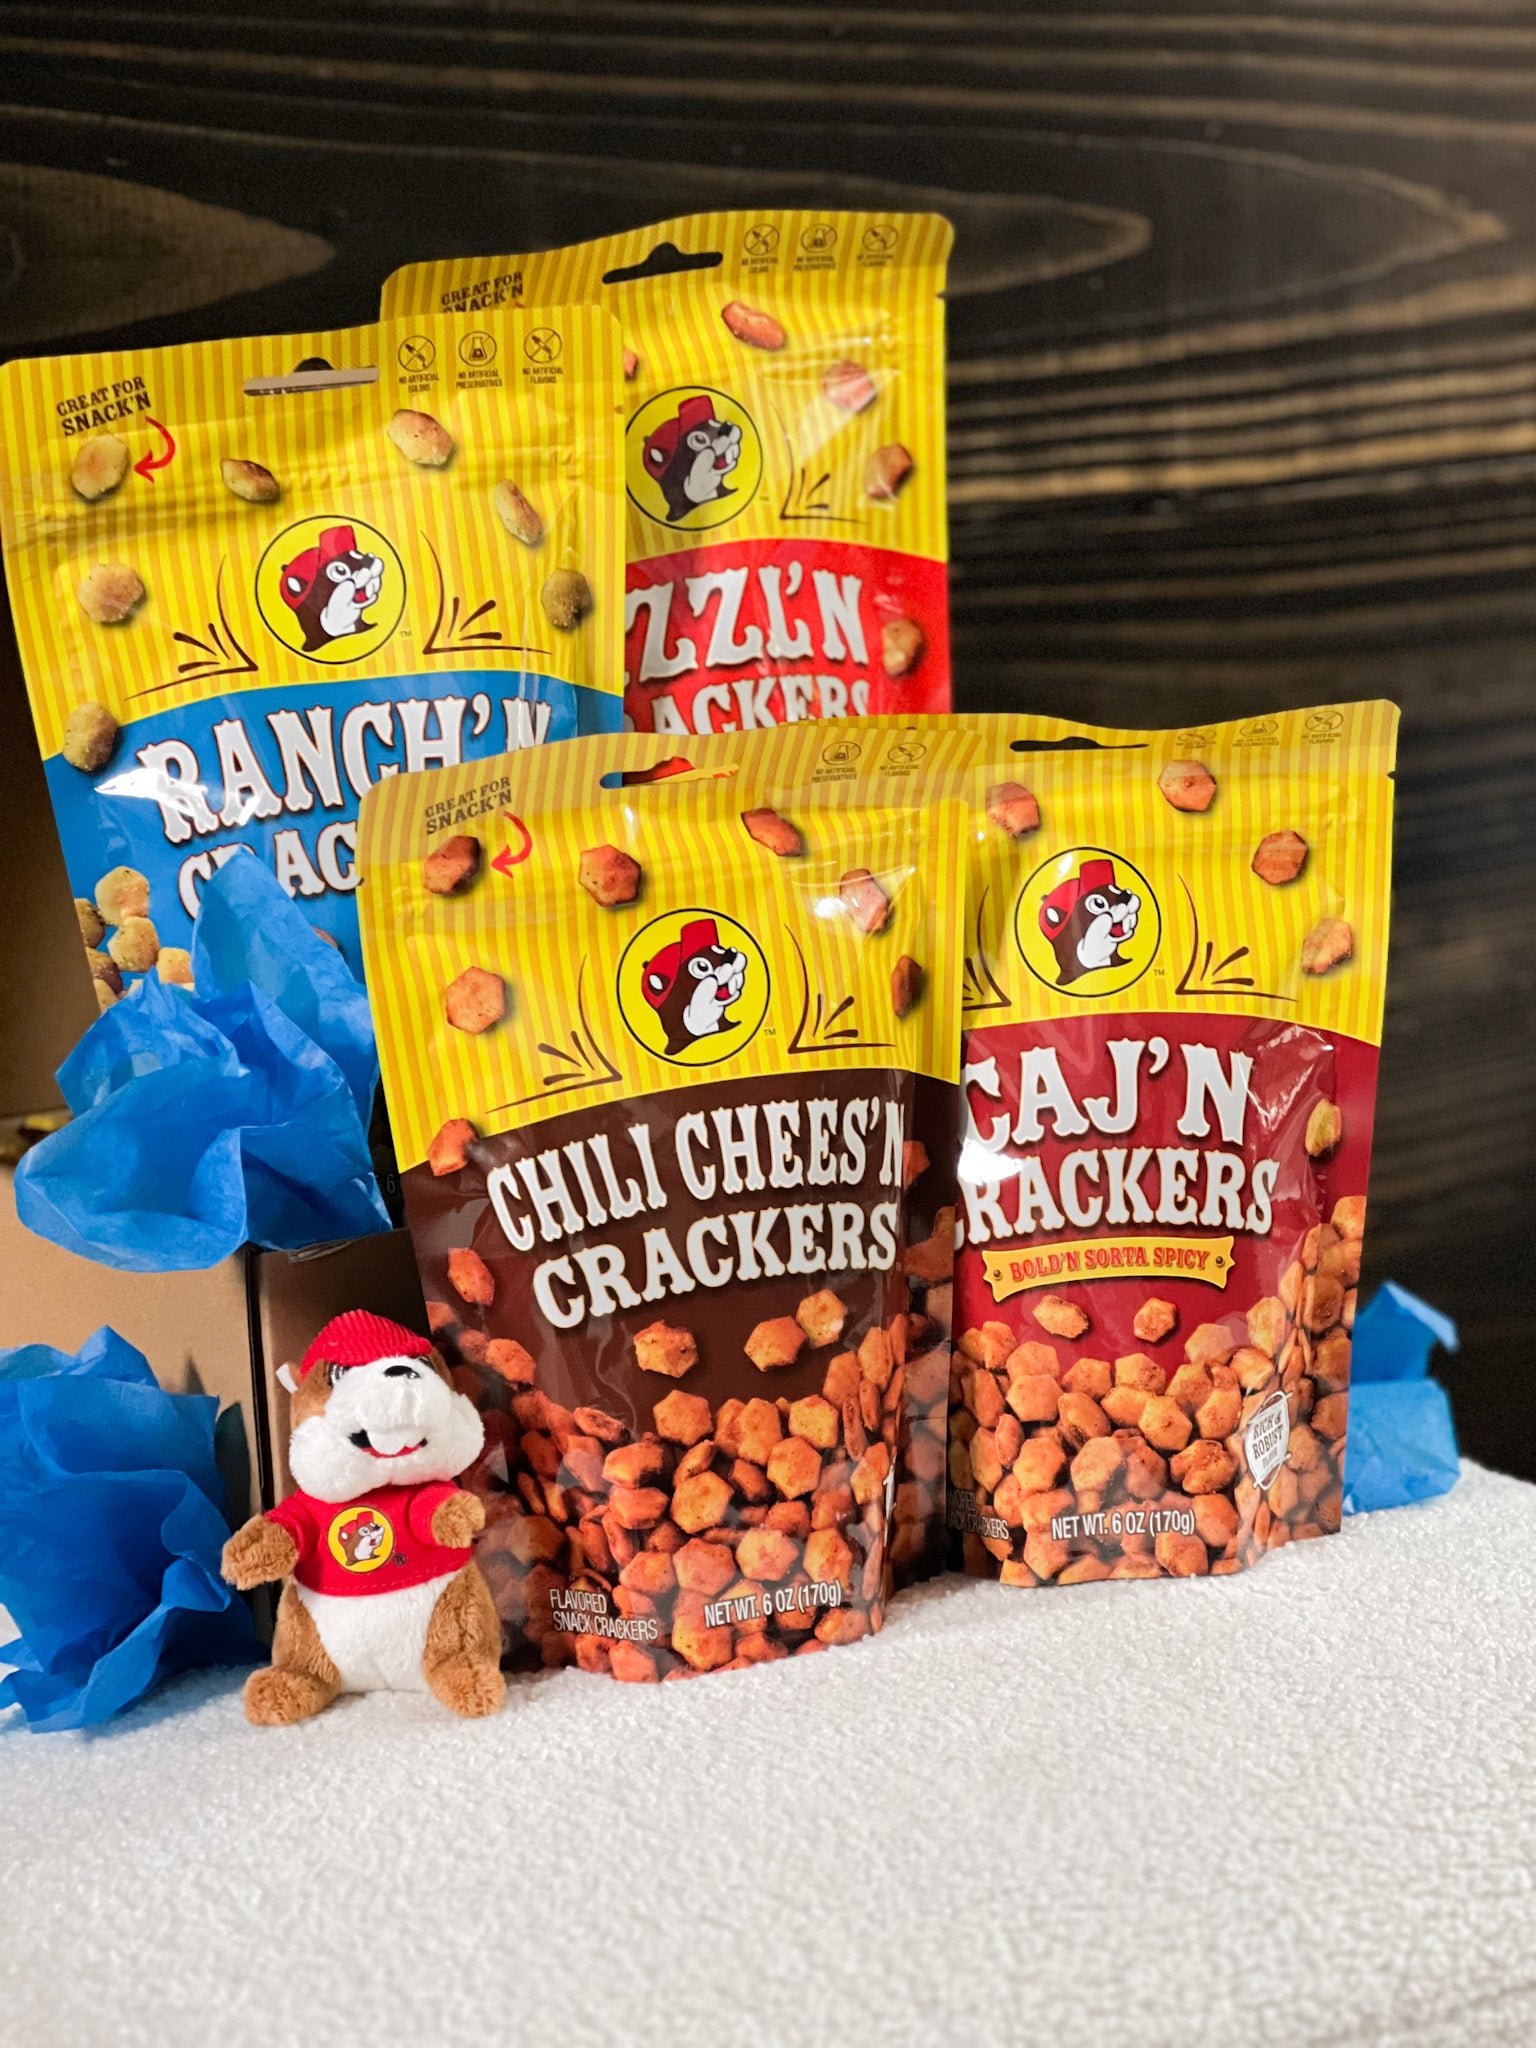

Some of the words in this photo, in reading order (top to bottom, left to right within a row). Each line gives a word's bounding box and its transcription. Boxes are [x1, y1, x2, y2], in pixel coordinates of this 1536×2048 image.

[441, 280, 490, 305] GREAT
[494, 271, 523, 288] FOR
[56, 388, 109, 417] GREAT
[114, 376, 146, 397] FOR
[61, 391, 151, 436] SNACK'N
[624, 560, 869, 690] ZZL'N
[624, 674, 870, 735] ACKERS
[136, 692, 552, 845] RANCH'N
[424, 788, 477, 818] GREAT
[480, 776, 511, 797] FOR
[426, 789, 513, 835] SNACK'N
[960, 1036, 1254, 1155] CAJ'N
[486, 1122, 667, 1251] CHILI
[675, 1096, 904, 1200] CHEES'N
[954, 1146, 1281, 1250] RACKERS
[533, 1202, 898, 1329] CRACKERS
[1009, 1250, 1080, 1282] BOLD'N
[1084, 1246, 1148, 1269] SORTA
[1153, 1246, 1210, 1271] SPICY
[1252, 1423, 1284, 1460] ROBUST
[1253, 1413, 1274, 1441] RICH
[1051, 1516, 1080, 1541] NET
[1083, 1513, 1108, 1537] WT.
[1111, 1513, 1122, 1535] 6
[1125, 1512, 1146, 1535] OZ
[1149, 1509, 1195, 1537] (170g)
[549, 1588, 607, 1615] FLAVORED
[704, 1601, 732, 1628] NET
[734, 1596, 760, 1621] WT.
[763, 1596, 772, 1616] 6
[775, 1594, 794, 1614] OZ
[797, 1578, 842, 1614] (170g)
[553, 1611, 593, 1635] SNACK
[594, 1615, 658, 1641] CRACKERS
